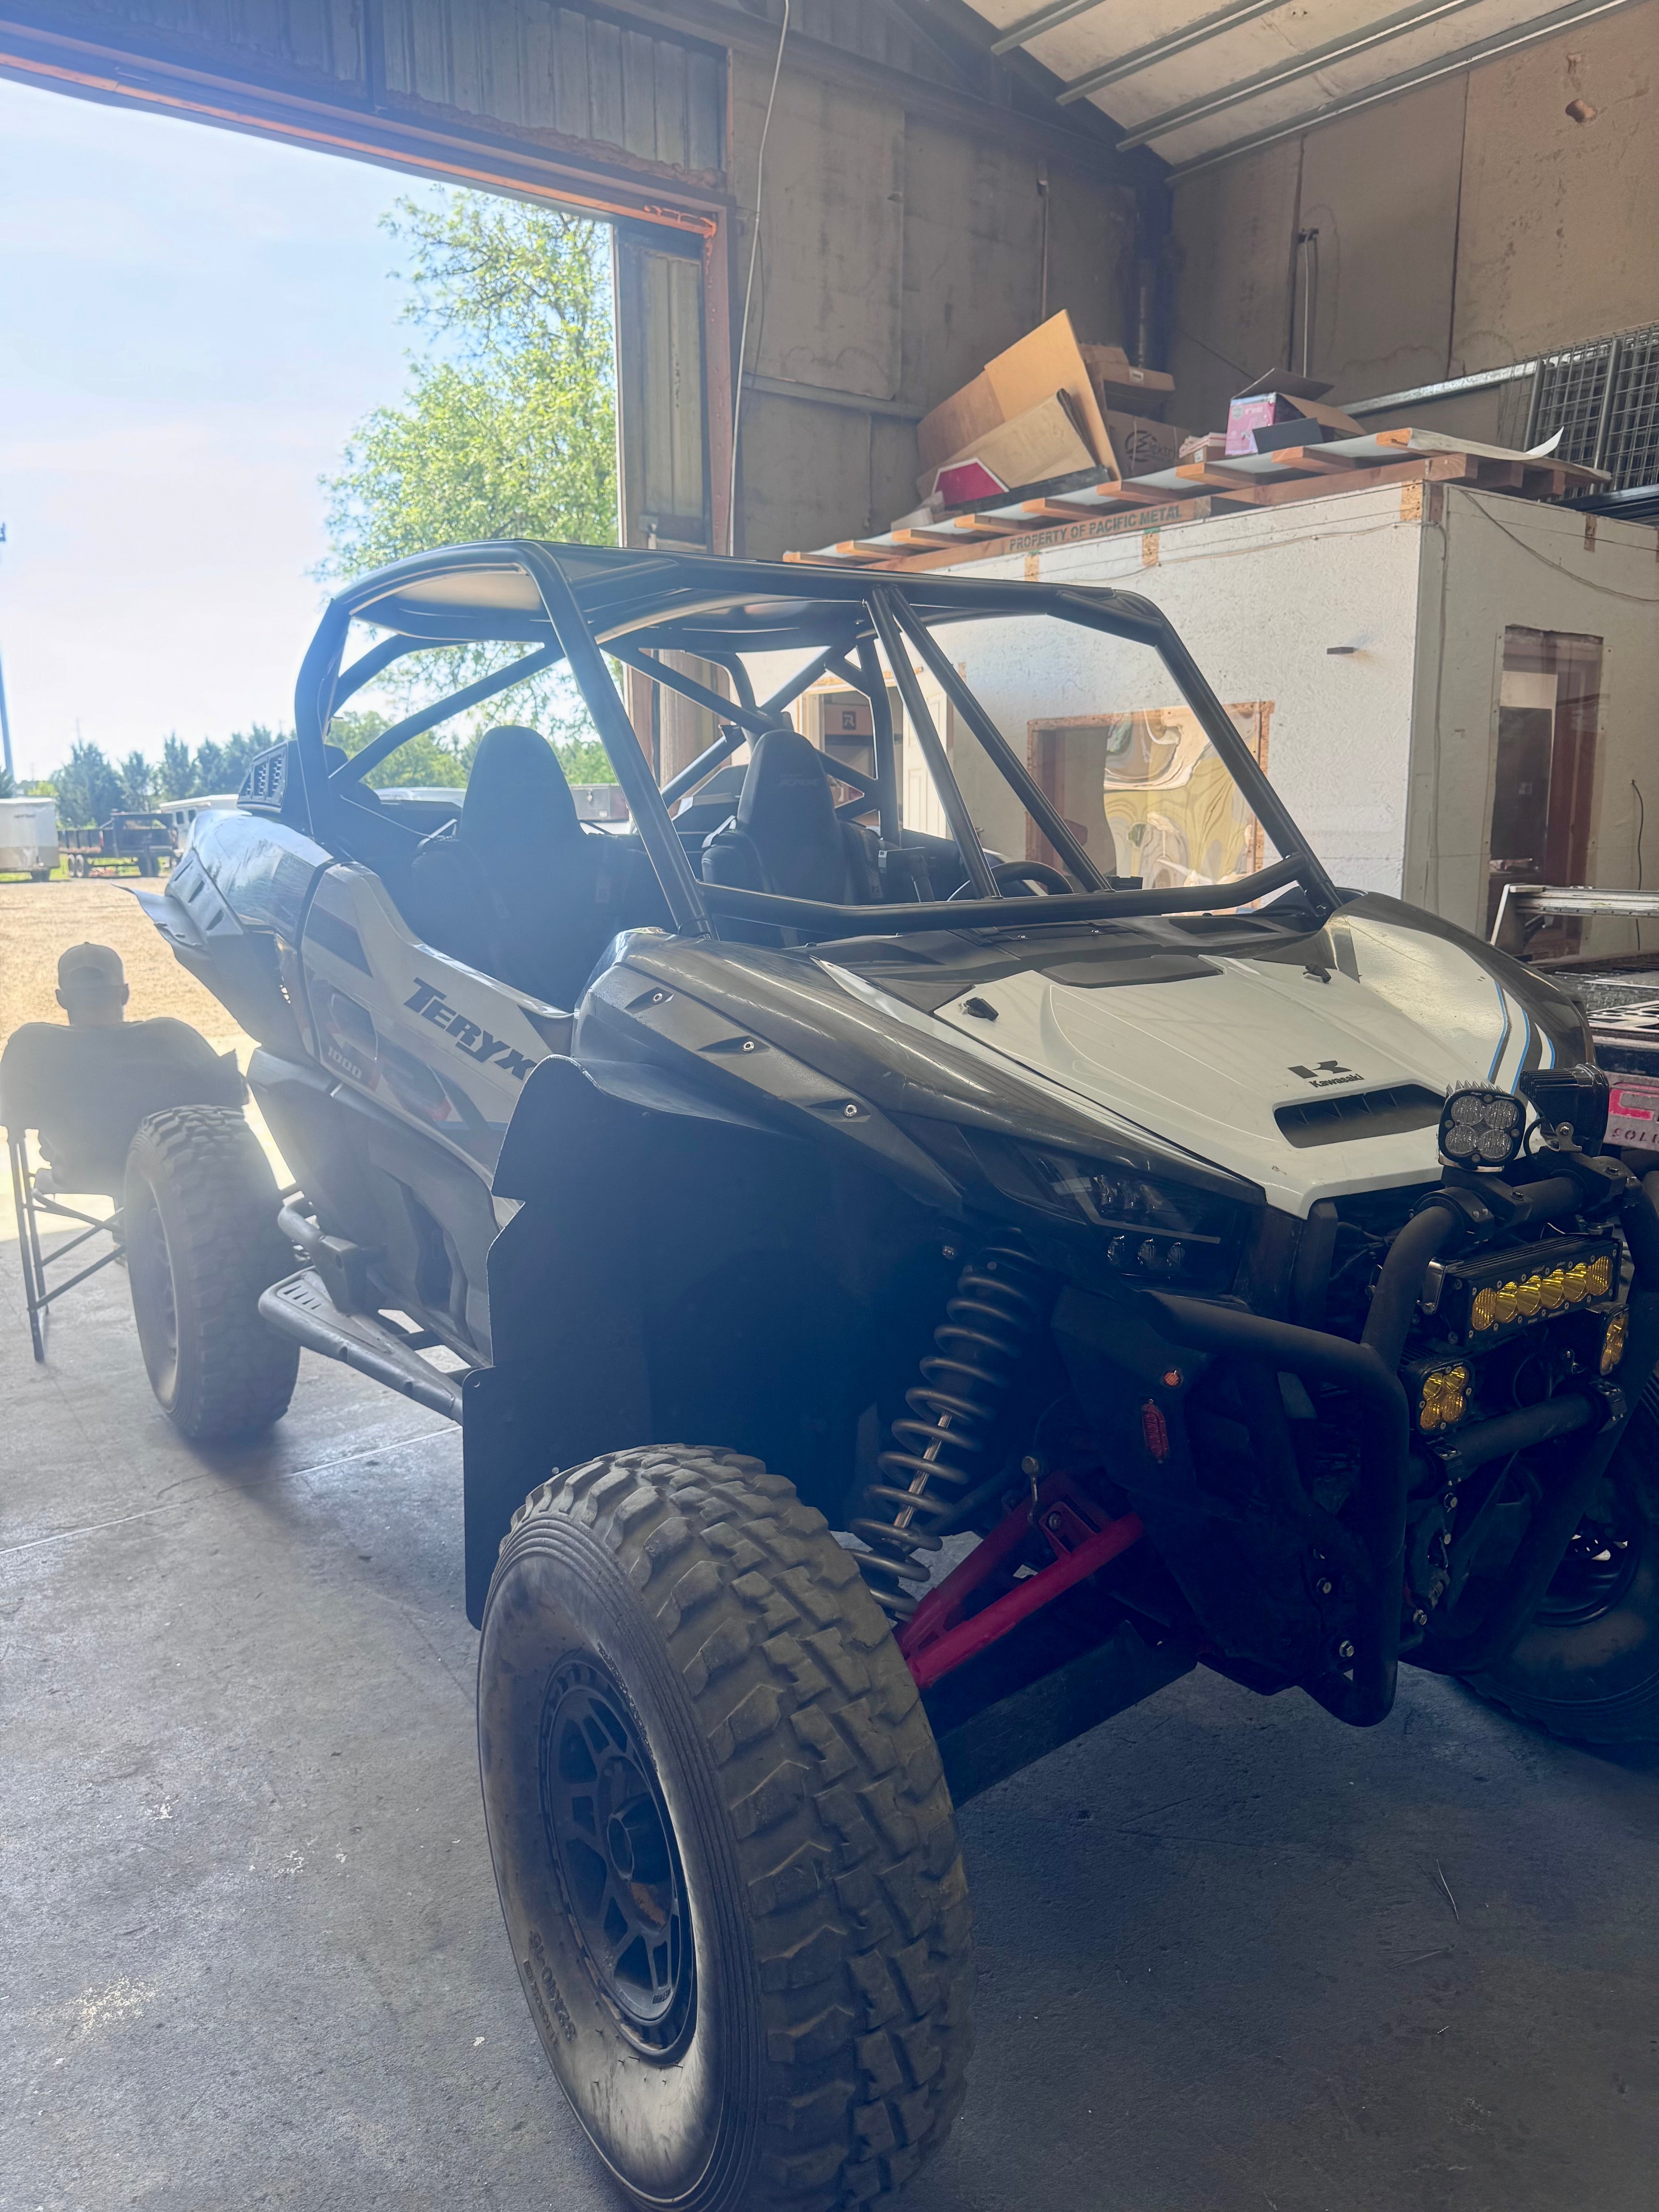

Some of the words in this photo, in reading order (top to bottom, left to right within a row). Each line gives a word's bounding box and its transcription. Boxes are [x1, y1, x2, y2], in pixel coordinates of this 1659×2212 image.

[1010, 528, 1067, 551] PROPERTY
[1071, 525, 1085, 538] OF
[1089, 514, 1136, 535] PACIFIC
[1140, 506, 1181, 525] METAL
[404, 977, 538, 1080] TERYX
[328, 1045, 362, 1079] 1000
[1309, 1074, 1365, 1087] Kawasaki
